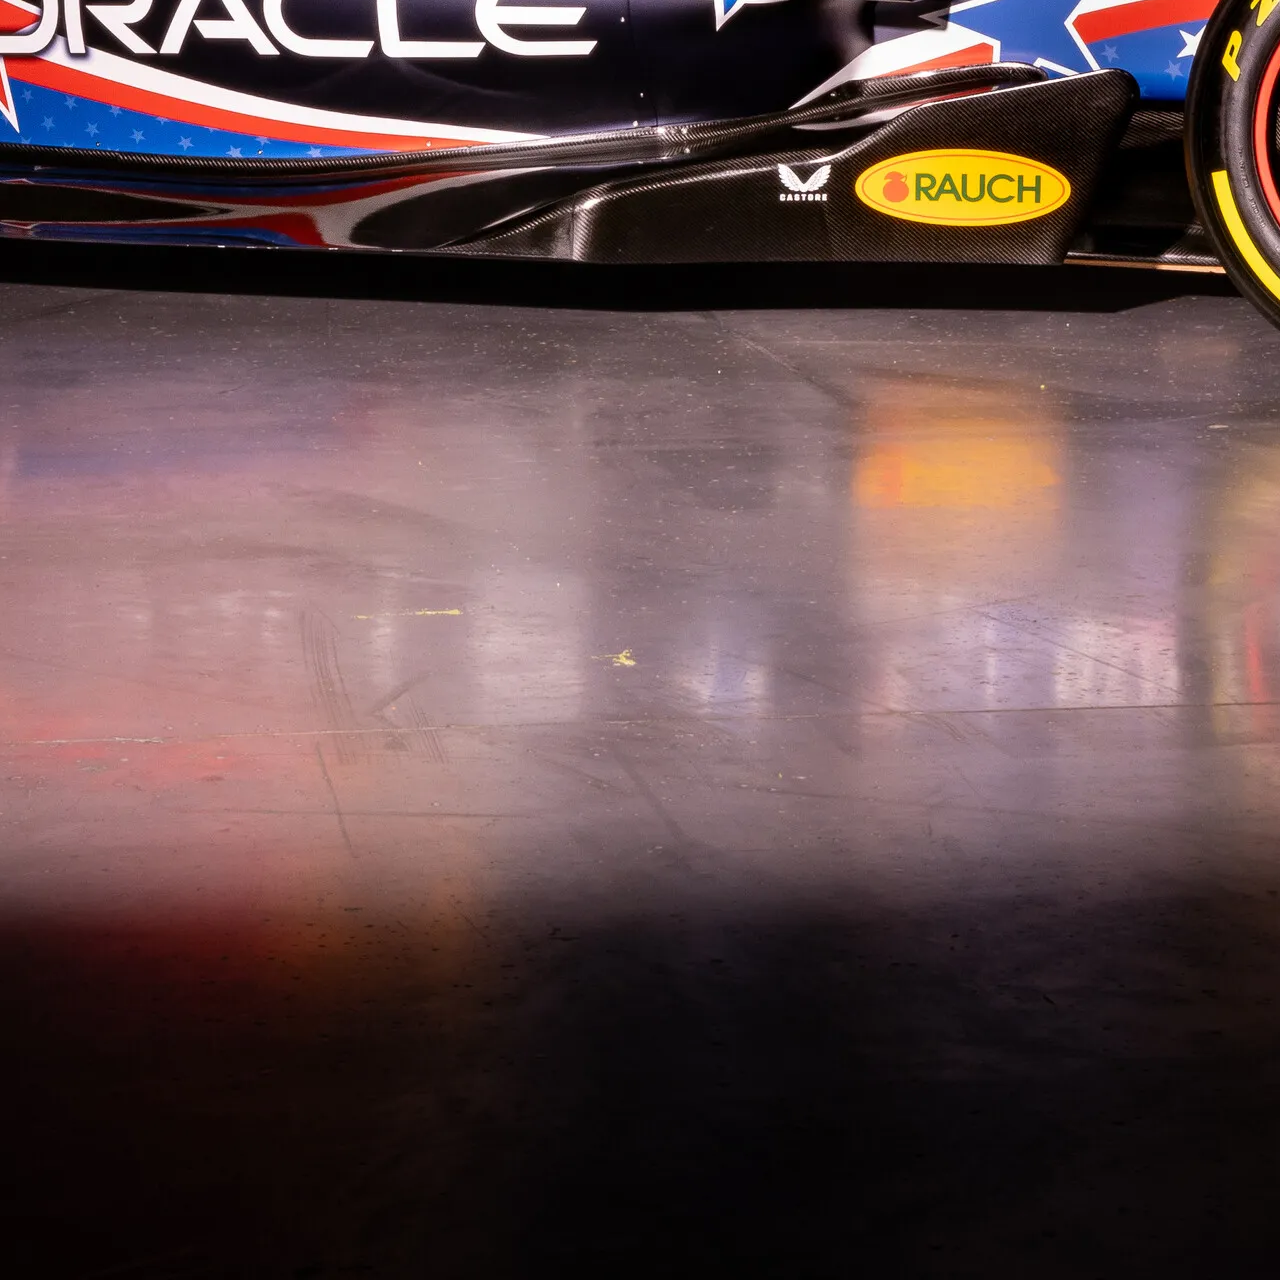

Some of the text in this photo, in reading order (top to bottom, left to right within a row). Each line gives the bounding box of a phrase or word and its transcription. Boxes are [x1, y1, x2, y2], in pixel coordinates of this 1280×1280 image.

[1221, 31, 1245, 82] P
[779, 193, 828, 201] CASTORE
[915, 172, 1041, 203] RAUCH
